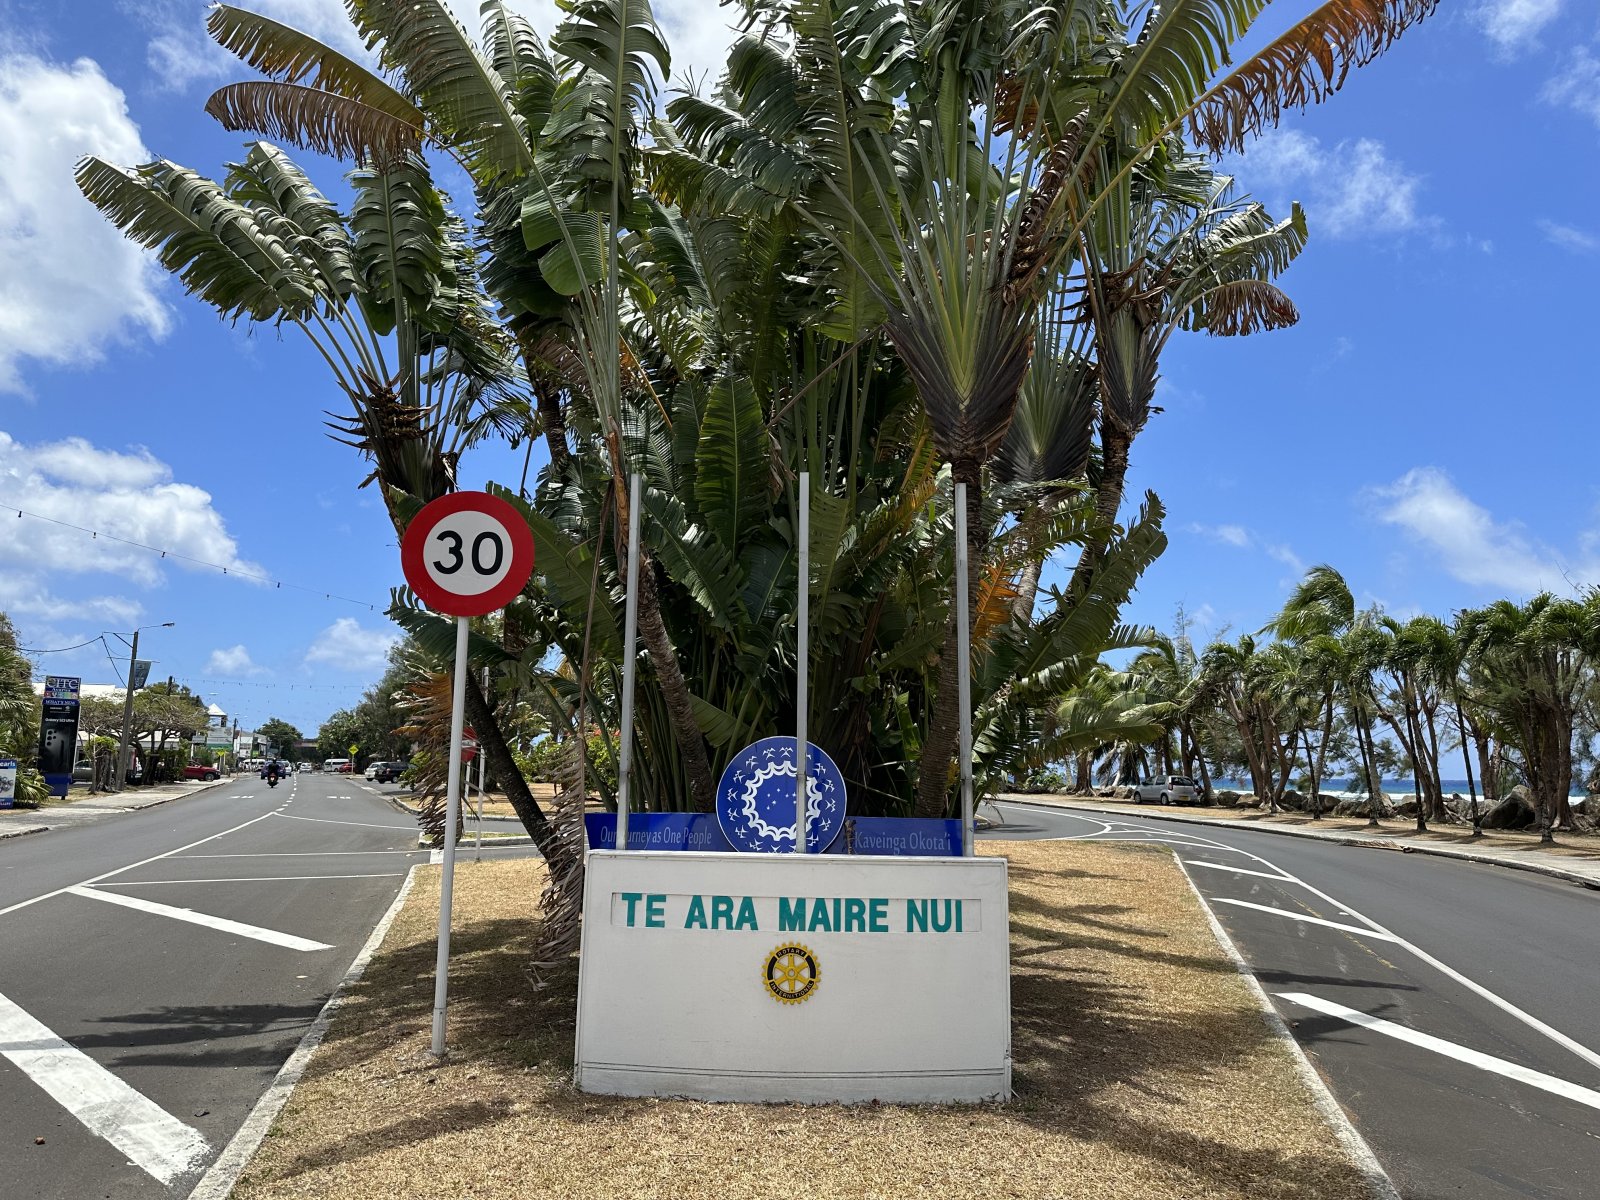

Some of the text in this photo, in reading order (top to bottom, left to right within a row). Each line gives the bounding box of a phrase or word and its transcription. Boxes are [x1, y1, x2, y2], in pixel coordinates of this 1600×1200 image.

[433, 530, 503, 575] 30
[46, 678, 77, 689] CITC
[600, 826, 712, 850] Our urney as One People
[855, 832, 906, 855] Kaveinga
[622, 892, 963, 932] TE ARA MAIRE NUI
[777, 948, 806, 957] ROTARY
[770, 981, 814, 999] INTERNATIONAL
